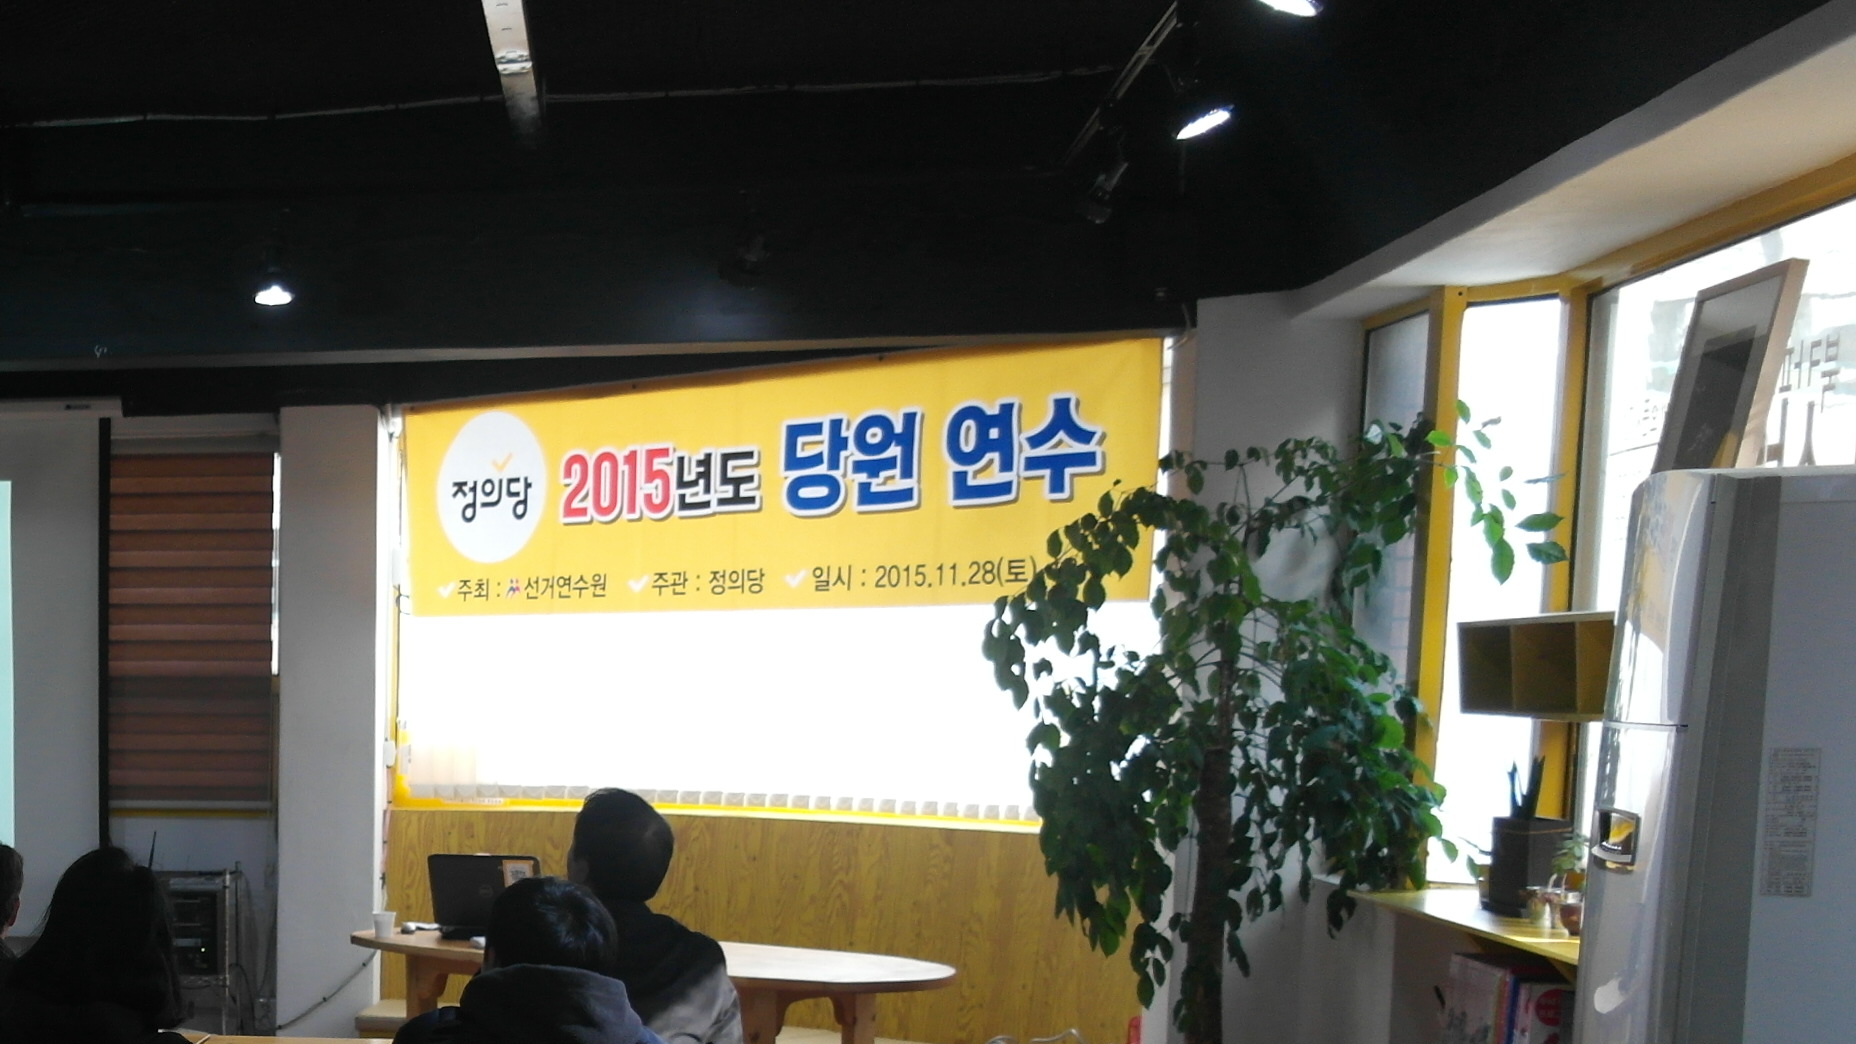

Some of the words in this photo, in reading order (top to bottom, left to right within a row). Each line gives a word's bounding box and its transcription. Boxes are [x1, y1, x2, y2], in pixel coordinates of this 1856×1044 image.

[561, 445, 760, 521] 2015년도
[783, 410, 919, 512] 당원
[945, 396, 1099, 501] 연수
[451, 475, 533, 524] 정의당
[456, 577, 491, 602] 주최
[523, 573, 608, 600] 선거연수원
[650, 570, 689, 597] 주관
[708, 567, 765, 595] 정의당
[811, 564, 852, 592] 일시
